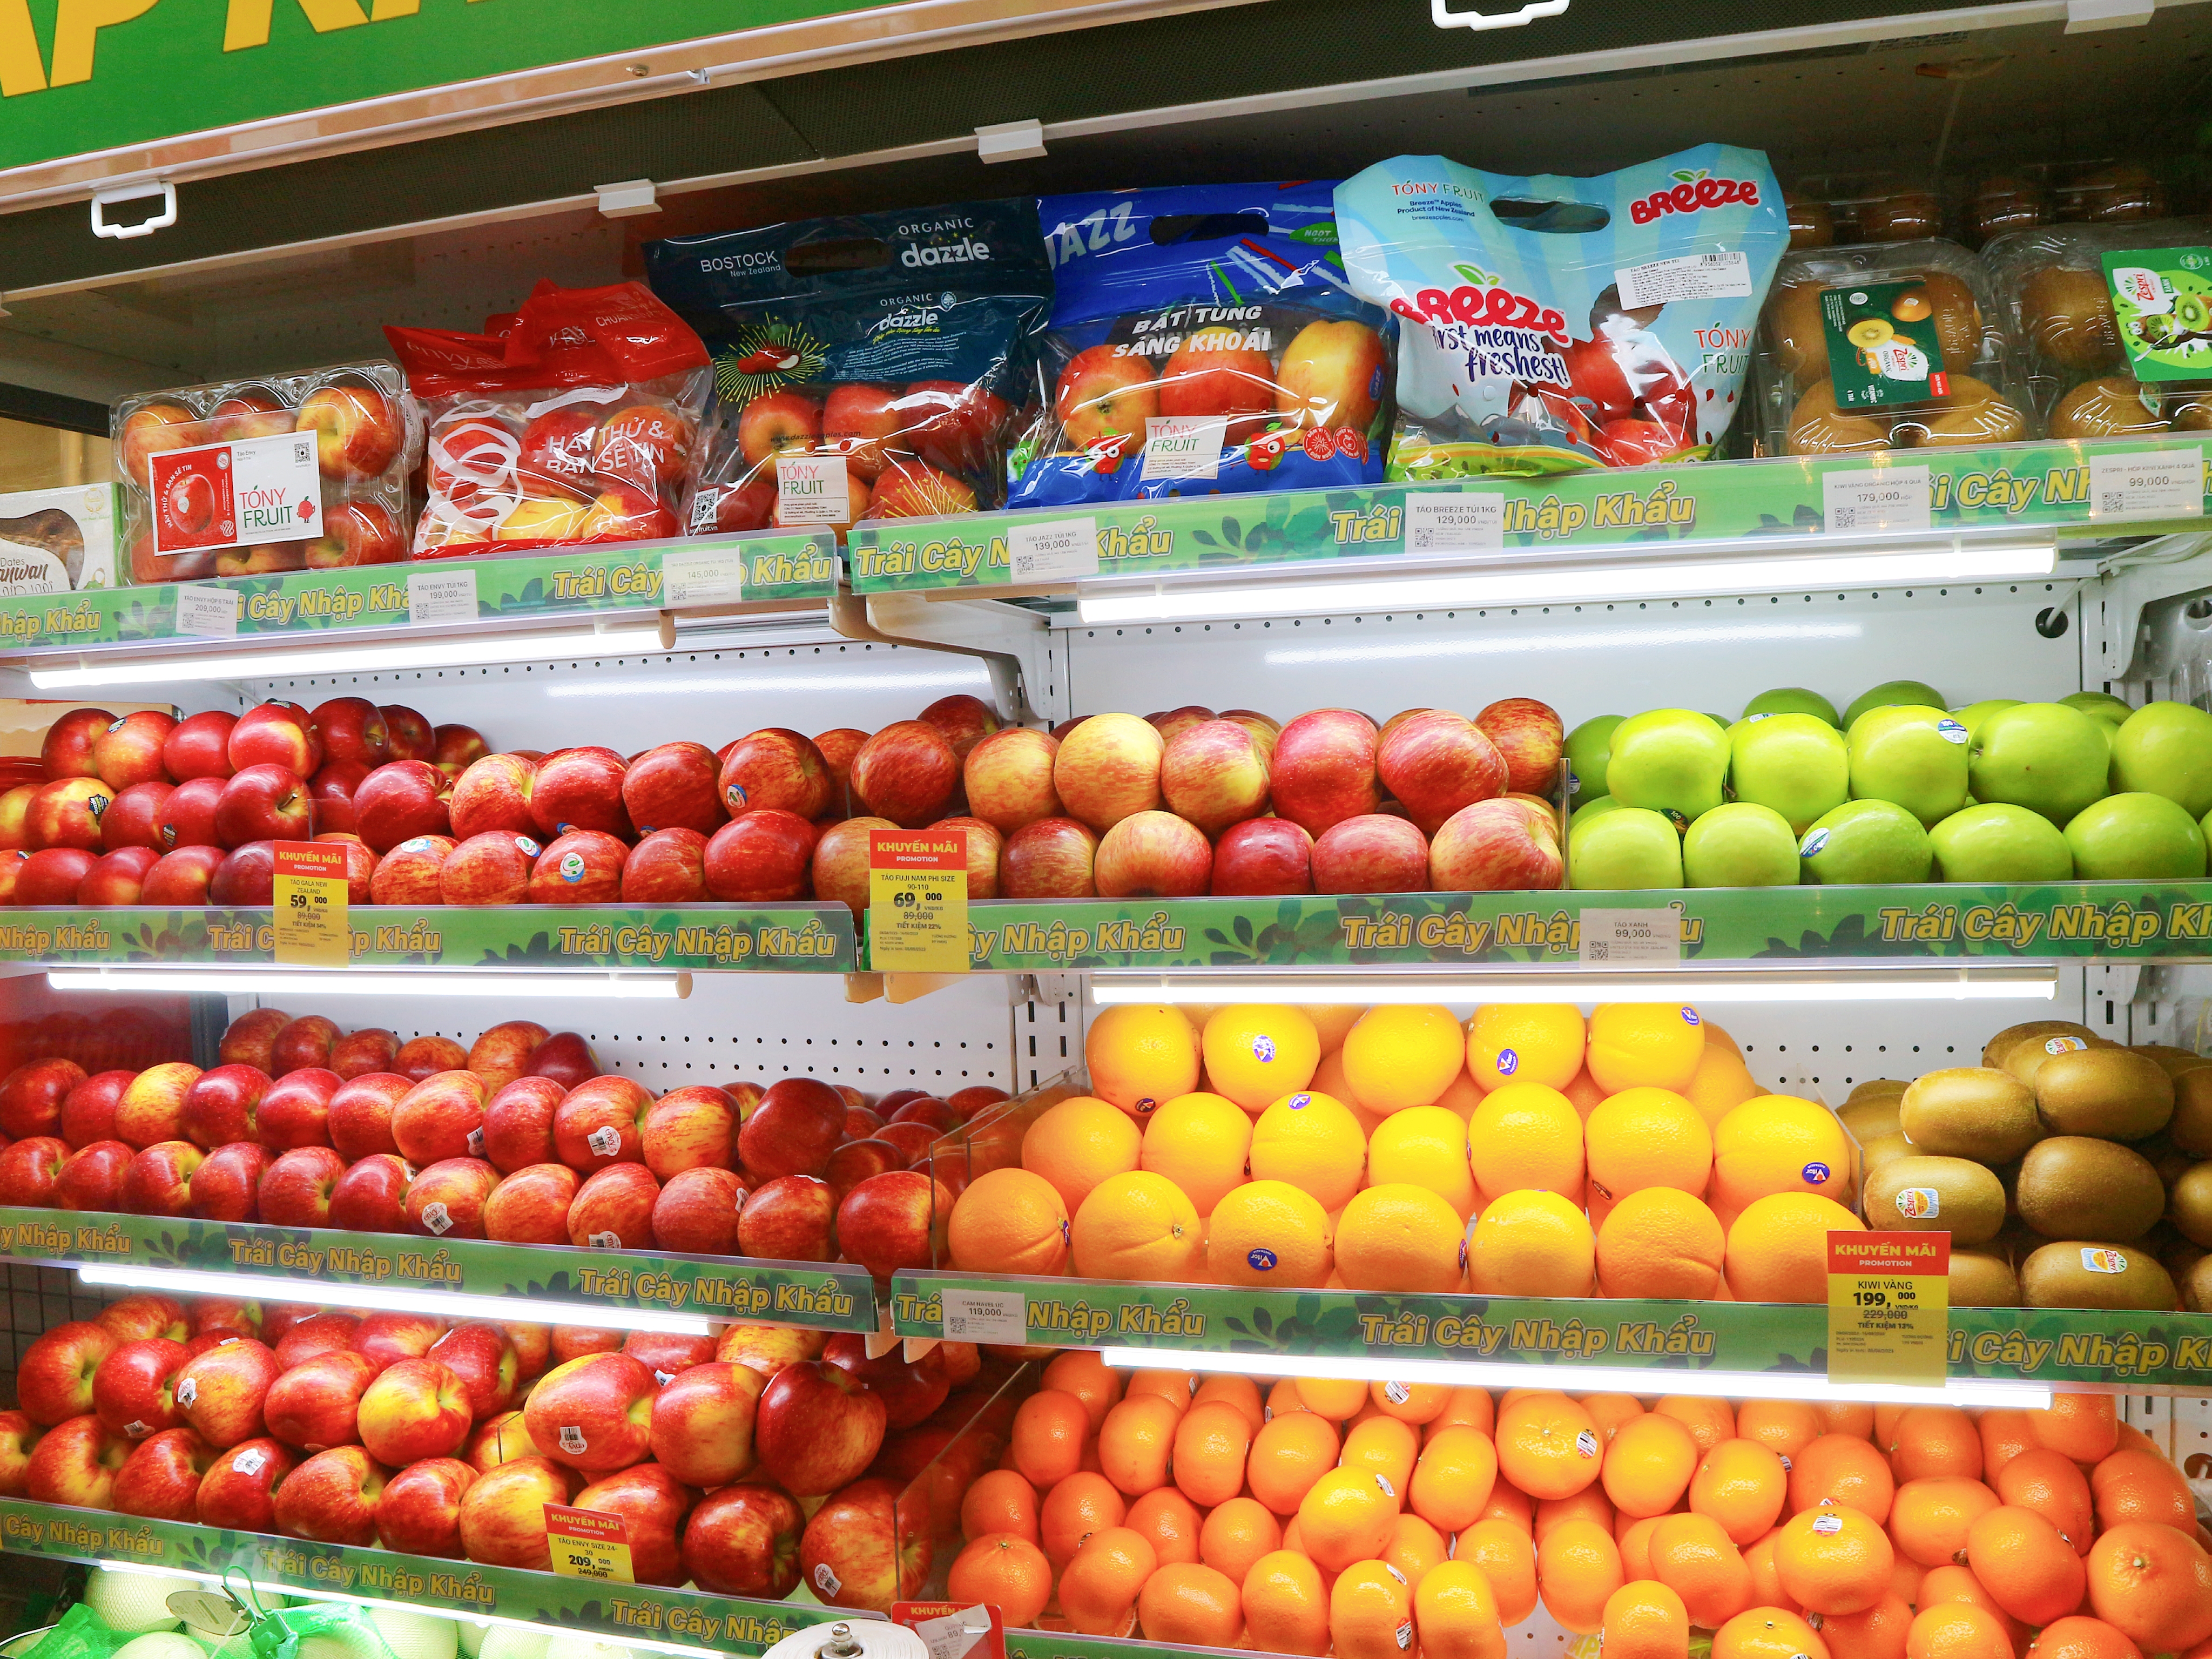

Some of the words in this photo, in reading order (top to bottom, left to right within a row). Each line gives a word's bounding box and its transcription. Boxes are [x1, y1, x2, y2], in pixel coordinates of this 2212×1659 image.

[1392, 180, 1438, 195] TÓNY
[1443, 184, 1484, 203] FRUIT
[1441, 200, 1462, 208] Apples
[1451, 207, 1475, 217] Zealand
[899, 218, 974, 235] ORGANIC
[901, 238, 990, 268] dazzle
[700, 251, 778, 272] BOSTOCK
[730, 269, 747, 277] New
[748, 265, 781, 275] Zealand
[2133, 272, 2155, 301] Zespri
[2162, 278, 2173, 293] XANH
[880, 293, 933, 307] ORGANIC
[879, 309, 938, 331] dazzle
[1196, 306, 1262, 322] TUNG
[1111, 334, 1180, 358] SẢNG
[1189, 326, 1271, 353] KHOÁI
[1475, 328, 1540, 354] means
[1694, 322, 1751, 349] TÓNY
[1465, 347, 1568, 385] freshest!
[1703, 353, 1749, 375] FRUIT
[1883, 351, 1892, 373] ORGANIC
[1893, 348, 1910, 371] Zespri
[599, 416, 645, 445] THỬ
[648, 420, 663, 439] &
[1151, 439, 1199, 452] FRUIT
[602, 444, 628, 471] SẼ
[631, 441, 664, 463] TIN
[780, 461, 819, 480] TÓNY
[784, 480, 825, 495] FRUIT
[2129, 476, 2169, 488] 99,000
[239, 485, 286, 509] TÓNY
[1857, 491, 1899, 503] 179,000
[1958, 468, 2038, 514] Cây
[1417, 505, 1432, 513] TÁO
[1594, 478, 1695, 529] Khẩu
[244, 506, 293, 528] FRUIT
[1437, 516, 1476, 525] 129,000
[1035, 539, 1070, 551] 139,000
[1, 557, 25, 567] Dates
[752, 543, 833, 586] Khẩu
[552, 565, 610, 600] Trái
[687, 570, 719, 579] 145,000
[430, 591, 457, 599] 199,000
[195, 604, 221, 613] 209,000
[248, 591, 295, 625] Cây
[299, 588, 363, 622] Nhập
[45, 599, 101, 633] Khẩu
[878, 839, 929, 853] KHUYẾN
[933, 840, 957, 853] MÃI
[279, 851, 319, 862] KHUYẾN
[322, 853, 341, 864] MÃI
[926, 893, 942, 901] 000
[298, 912, 320, 920] 89,000
[903, 912, 933, 920] 89,000
[1879, 903, 1959, 940] Trái
[1962, 902, 2044, 948] Cây
[2049, 902, 2161, 948] Nhập
[558, 923, 611, 954] Trái
[616, 925, 671, 962] Cây
[676, 926, 752, 963] Nhập
[756, 919, 837, 957] Khẩu
[1001, 925, 1089, 965] Nhập
[1094, 912, 1185, 953] Khẩu
[1615, 929, 1651, 939] 99,000
[605, 1129, 616, 1145] envy
[1806, 1169, 1826, 1181] Vitor
[1905, 1189, 1917, 1216] Zespri
[424, 1208, 440, 1220] envy
[1835, 1242, 1900, 1256] KHUYẾN
[1906, 1243, 1936, 1257] MÃI
[1251, 1254, 1272, 1268] Vitor
[2107, 1249, 2116, 1272] Zespri
[1858, 1281, 1880, 1289] KIWI
[1883, 1279, 1913, 1290] VÀNG
[969, 1307, 1002, 1316] 119,000
[1864, 1310, 1907, 1320] 229,000
[1876, 1321, 1896, 1331] KIỆM
[1360, 1312, 1429, 1345] Trái
[1433, 1318, 1503, 1355] Cây
[1510, 1320, 1610, 1359] Nhập
[1615, 1315, 1716, 1355] Khẩu
[551, 1514, 596, 1527] KHUYẾN
[598, 1520, 619, 1530] MÃI
[5, 1513, 43, 1542] Cây
[49, 1519, 103, 1550] Nhập
[108, 1526, 164, 1556] Khẩu
[572, 1540, 589, 1548] ENVY
[578, 1568, 608, 1578] 249,000
